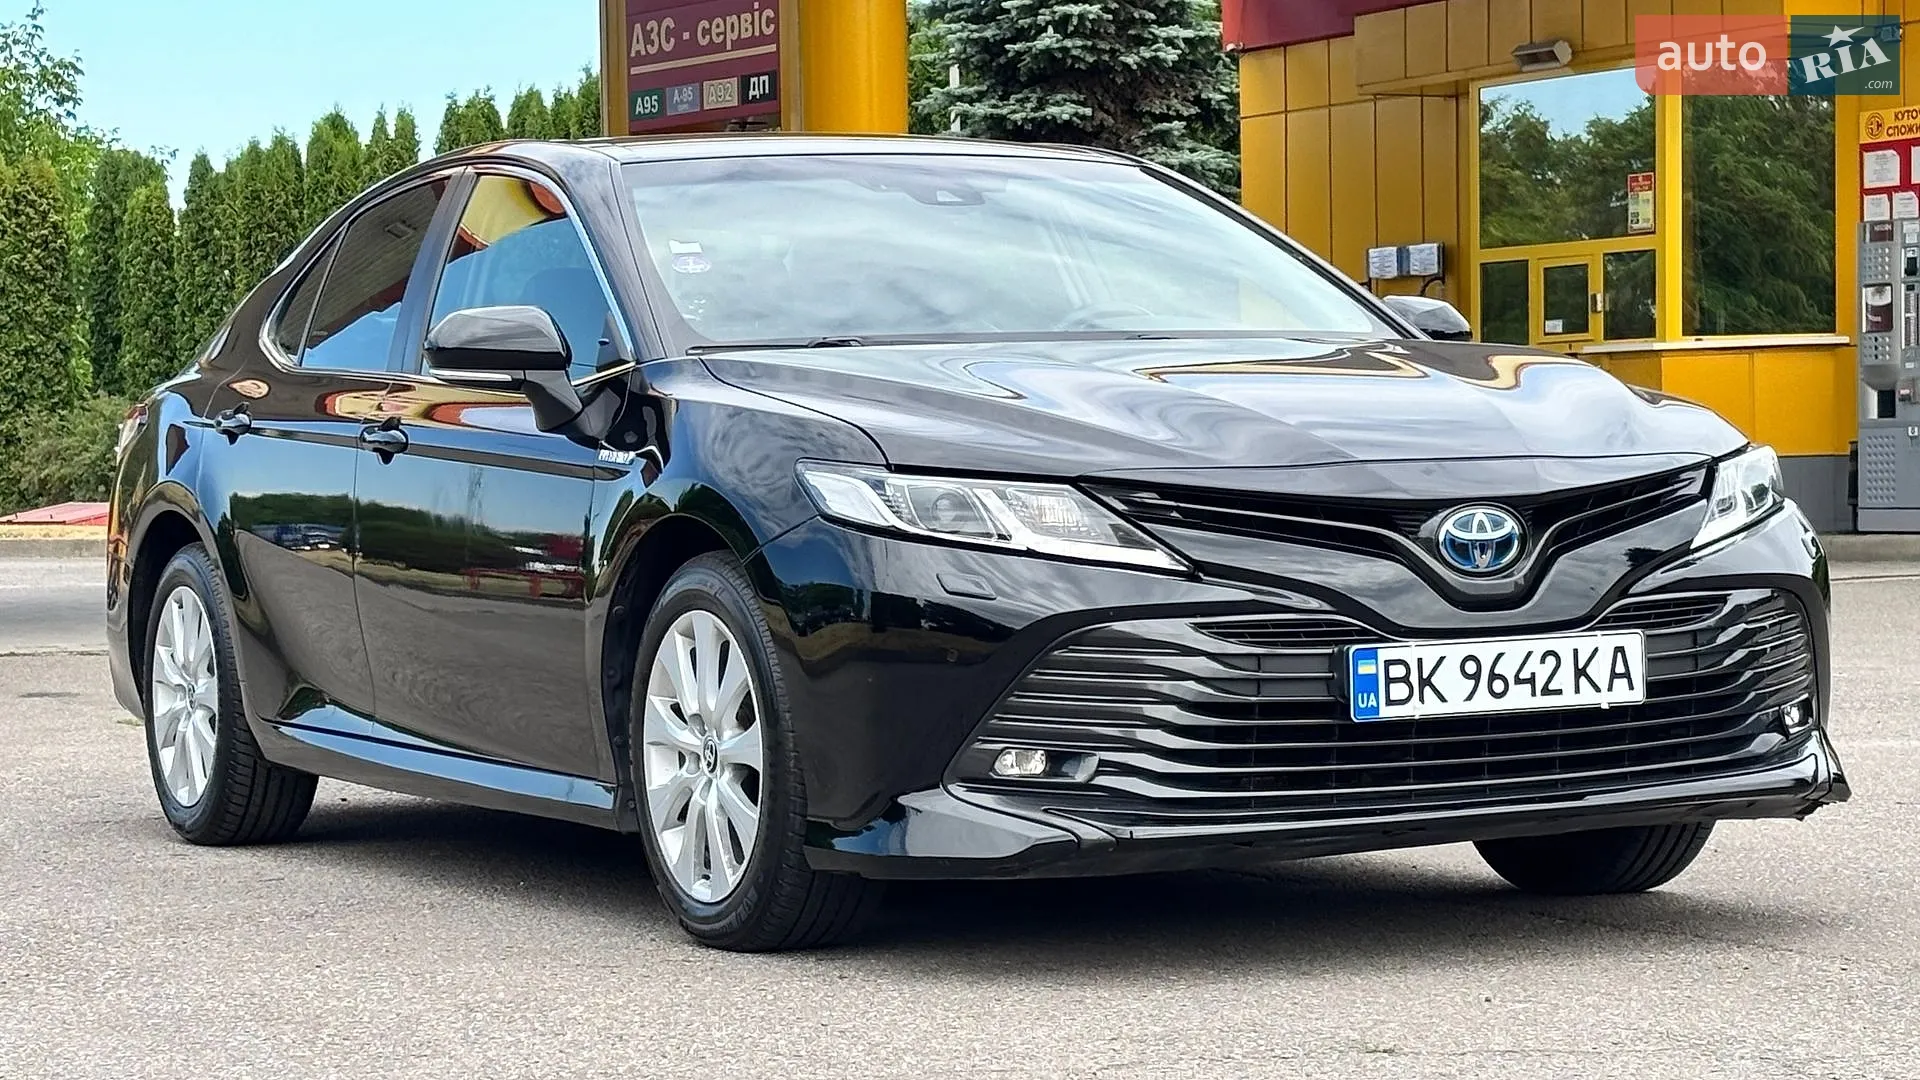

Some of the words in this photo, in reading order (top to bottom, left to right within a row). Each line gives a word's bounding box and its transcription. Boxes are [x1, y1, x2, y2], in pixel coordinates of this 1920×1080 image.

[630, 17, 676, 58] АЗС
[697, 2, 775, 50] сервіс
[749, 75, 769, 100] ДП
[1894, 108, 1920, 121] КУТО
[1384, 655, 1448, 706] BK
[1459, 650, 1563, 702] 9642
[1573, 645, 1635, 695] KA
[1358, 692, 1378, 708] UA
